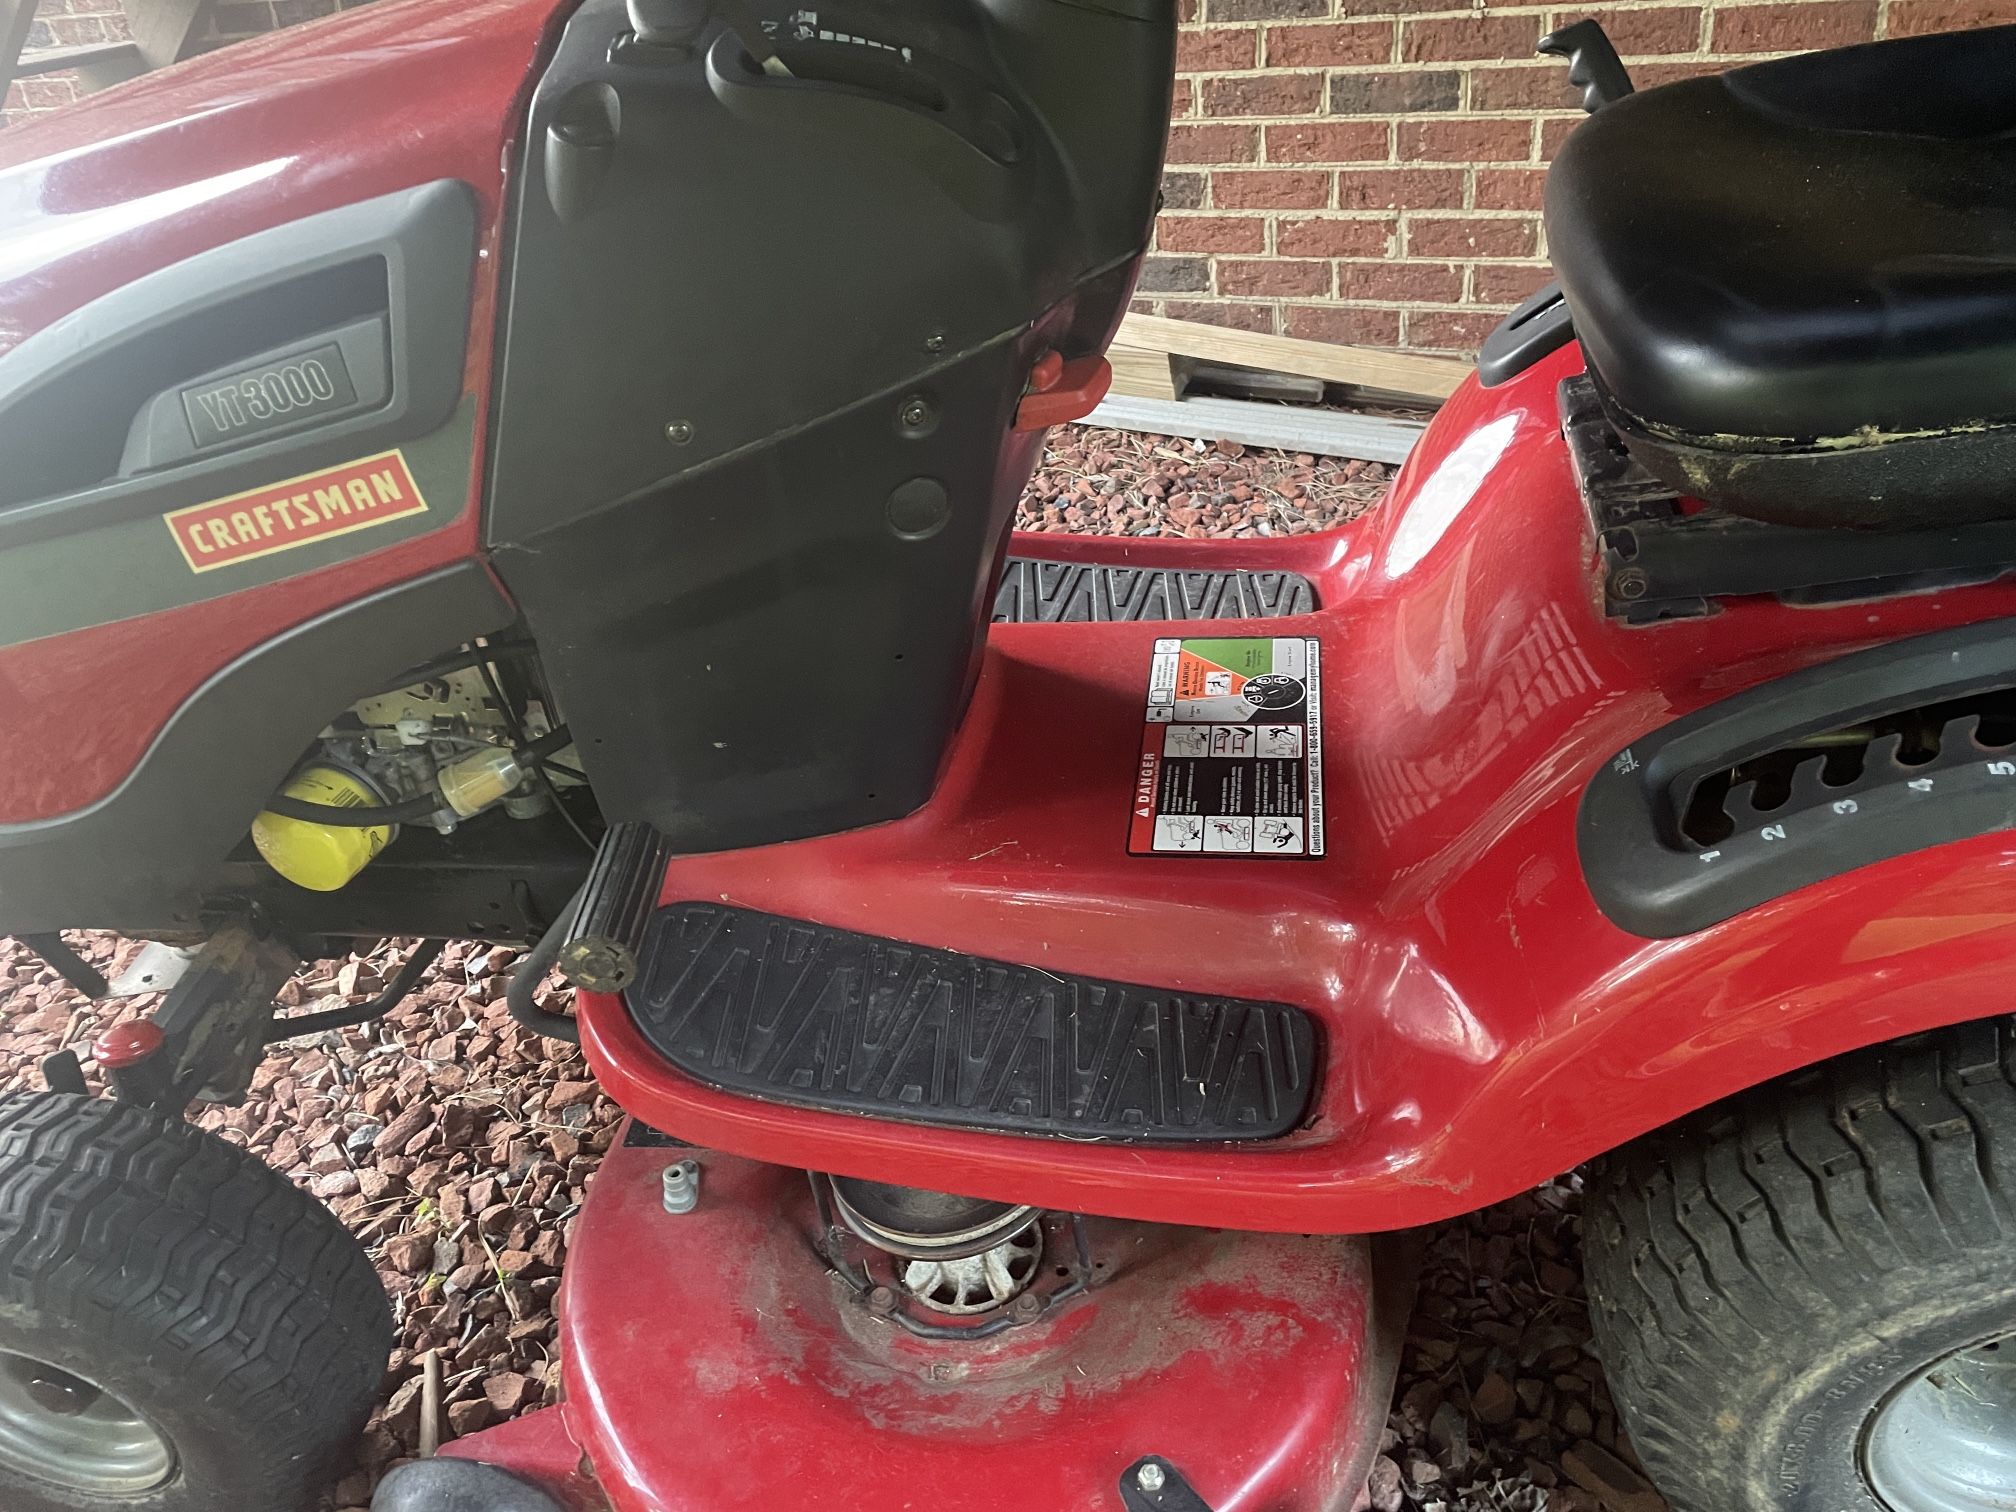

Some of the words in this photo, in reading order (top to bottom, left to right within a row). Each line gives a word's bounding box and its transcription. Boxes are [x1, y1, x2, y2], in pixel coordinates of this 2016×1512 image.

[187, 468, 404, 554] CRAFTSMAN
[1182, 661, 1191, 688] WARNING
[1309, 642, 1319, 692] managemyhome.com
[1309, 711, 1319, 754] 1-800-659-5917
[1310, 756, 1319, 768] Call:
[1138, 753, 1155, 803] DANGER
[1311, 770, 1320, 794] Product?
[1312, 794, 1321, 806] your
[1312, 807, 1320, 821] about
[1700, 850, 1721, 863] 1
[1761, 824, 1786, 841] 2
[1833, 799, 1858, 814] 3
[1908, 778, 1934, 792] 4
[1987, 761, 2016, 775] 5
[1311, 824, 1321, 853] Questions
